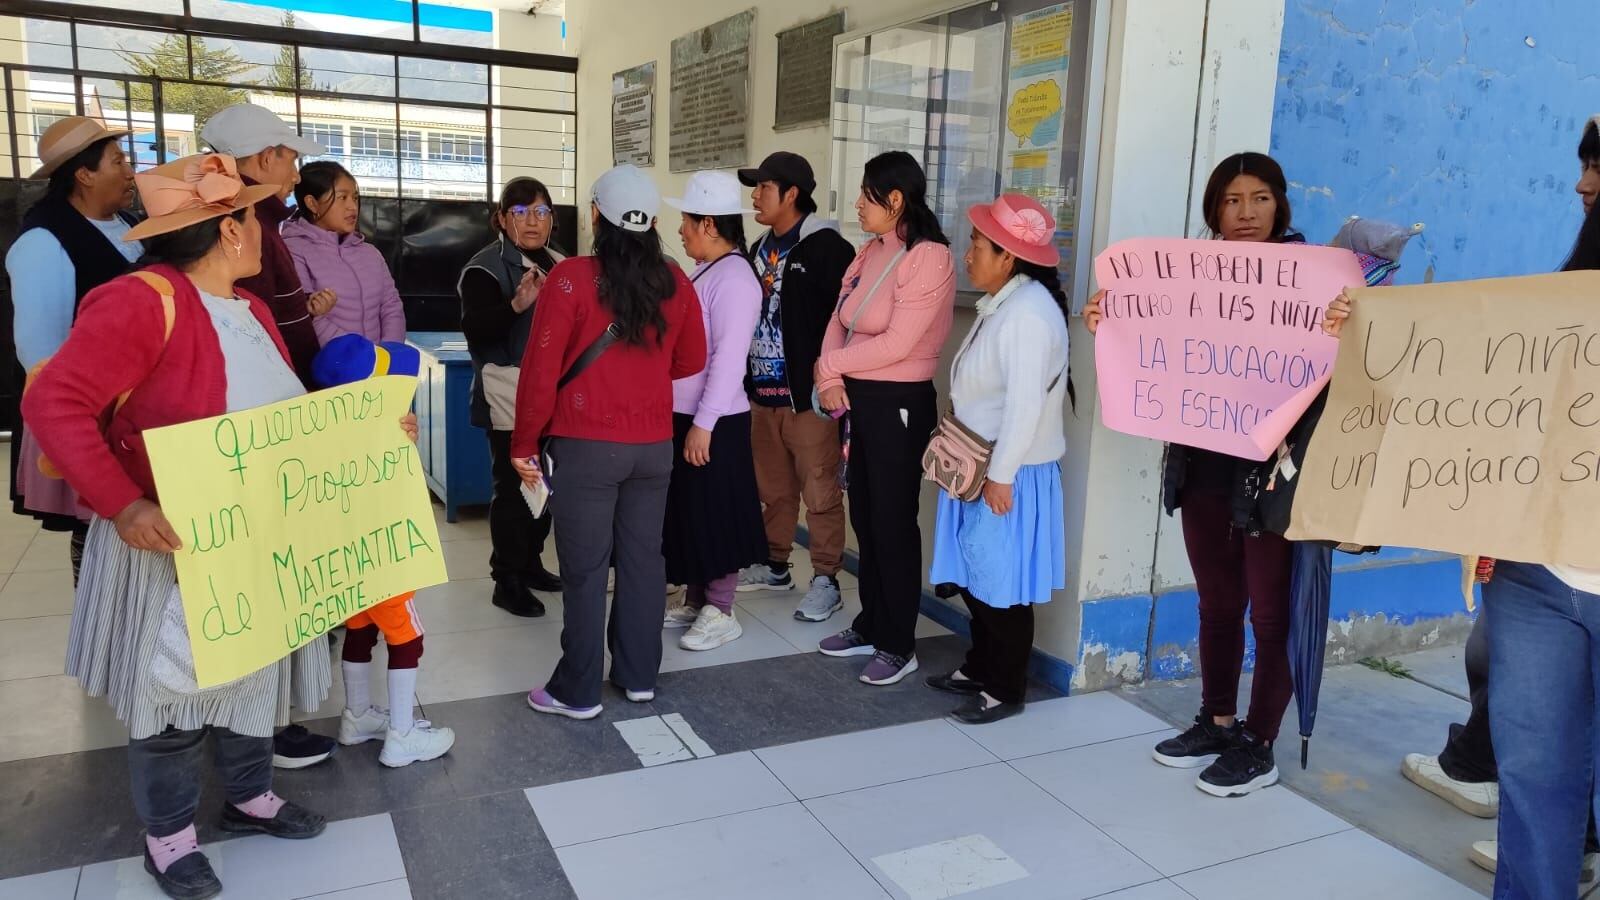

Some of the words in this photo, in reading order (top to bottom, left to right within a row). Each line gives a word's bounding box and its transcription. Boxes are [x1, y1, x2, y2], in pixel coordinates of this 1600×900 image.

[1109, 252, 1144, 280] NO
[1154, 250, 1179, 280] LE
[1190, 251, 1263, 285] ROBEN
[1277, 259, 1303, 289] EL
[1103, 289, 1173, 319] FUTURO
[1190, 291, 1203, 319] A
[1219, 291, 1255, 322] LAS
[1270, 300, 1325, 334] NIÑA
[1139, 334, 1168, 372] LA
[1183, 338, 1328, 388] EDUCACIÓN
[1363, 320, 1445, 381] Un
[1133, 379, 1164, 421] ES
[1180, 388, 1273, 436] ESENCI
[1340, 385, 1545, 434] educación
[190, 503, 250, 555] un
[276, 444, 414, 517] Profesor
[1331, 451, 1378, 491] un
[1402, 447, 1541, 511] pajaro
[202, 574, 252, 642] de
[272, 518, 434, 612] MATEMATICA
